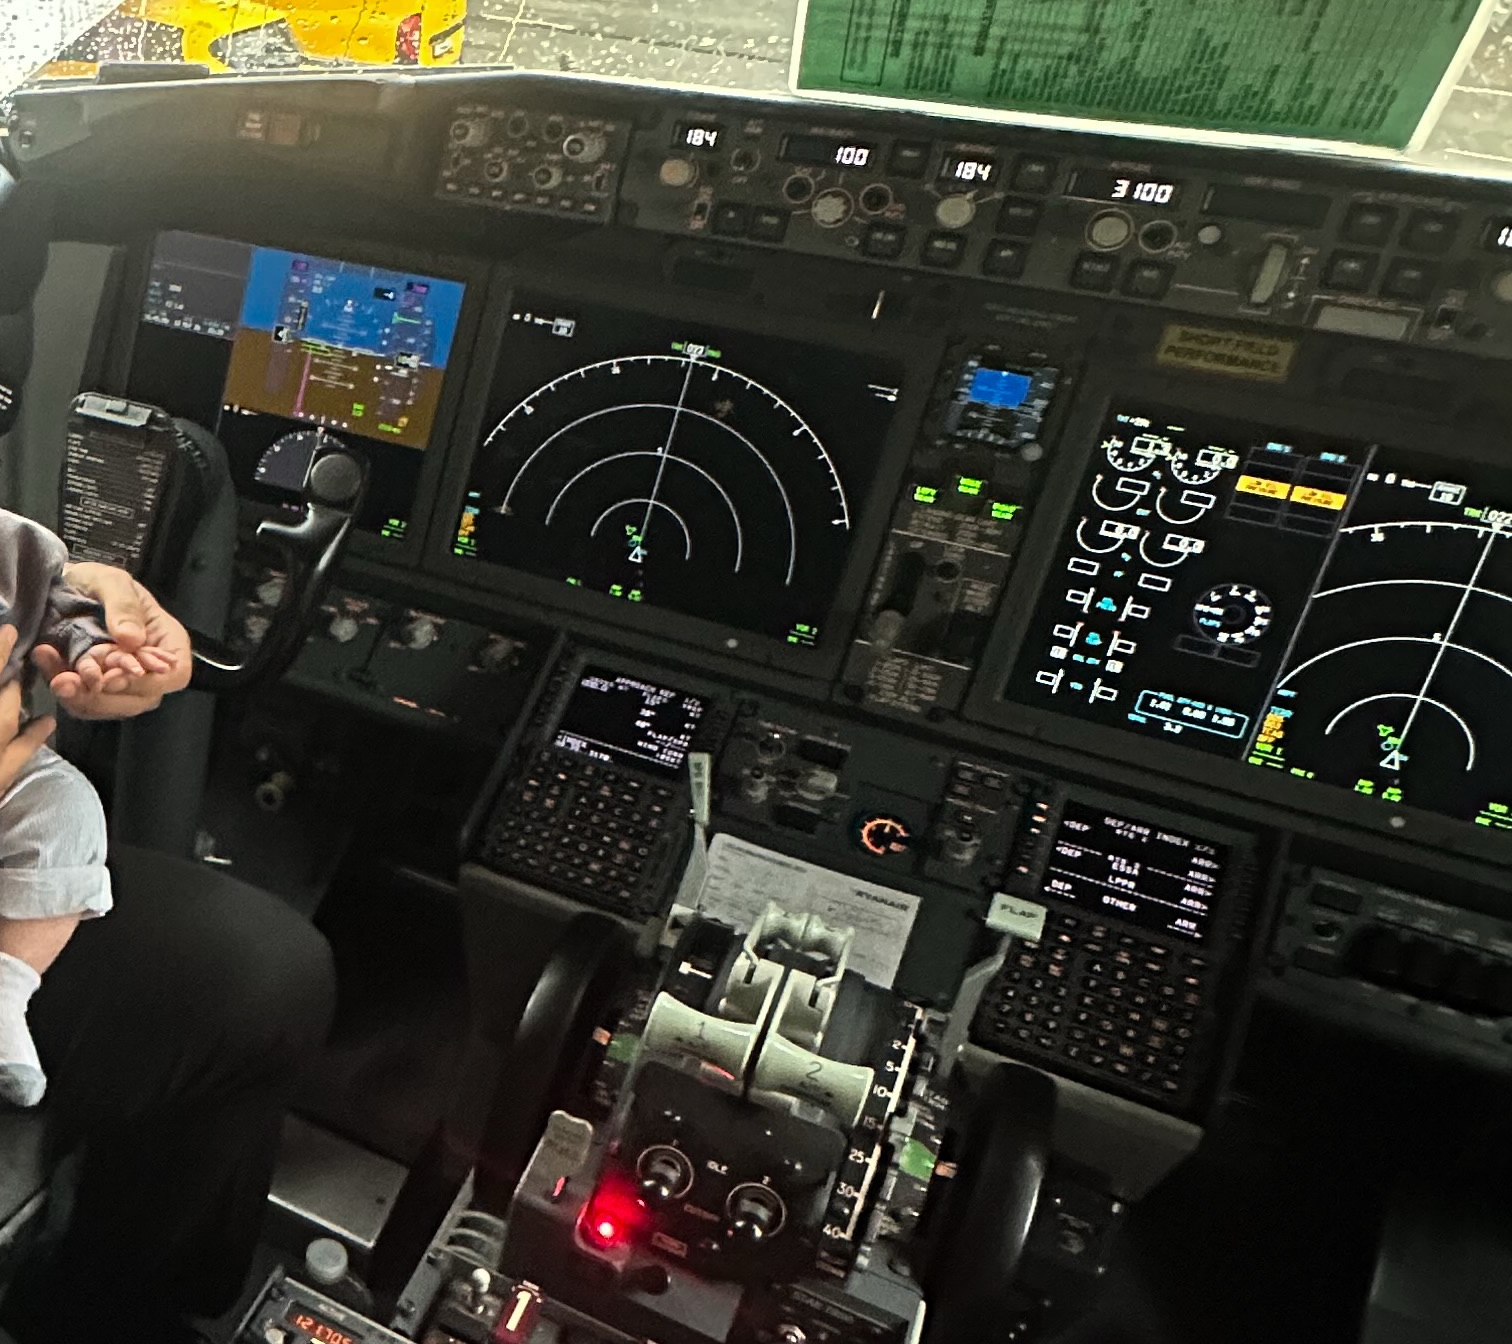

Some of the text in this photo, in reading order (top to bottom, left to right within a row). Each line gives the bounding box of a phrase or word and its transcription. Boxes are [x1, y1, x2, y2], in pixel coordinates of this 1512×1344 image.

[686, 128, 718, 148] 184
[834, 146, 870, 166] 100
[954, 161, 992, 182] 184
[1111, 178, 1174, 204] 3100
[1156, 832, 1190, 848] INDEX
[1000, 903, 1038, 919] FLAP
[696, 1020, 707, 1039] 1
[805, 1059, 824, 1082] 2
[885, 1061, 896, 1073] 5
[873, 1084, 888, 1098] 10
[848, 1148, 867, 1164] 25
[836, 1182, 857, 1199] 30
[823, 1223, 845, 1241] 40
[505, 1290, 532, 1331] 1
